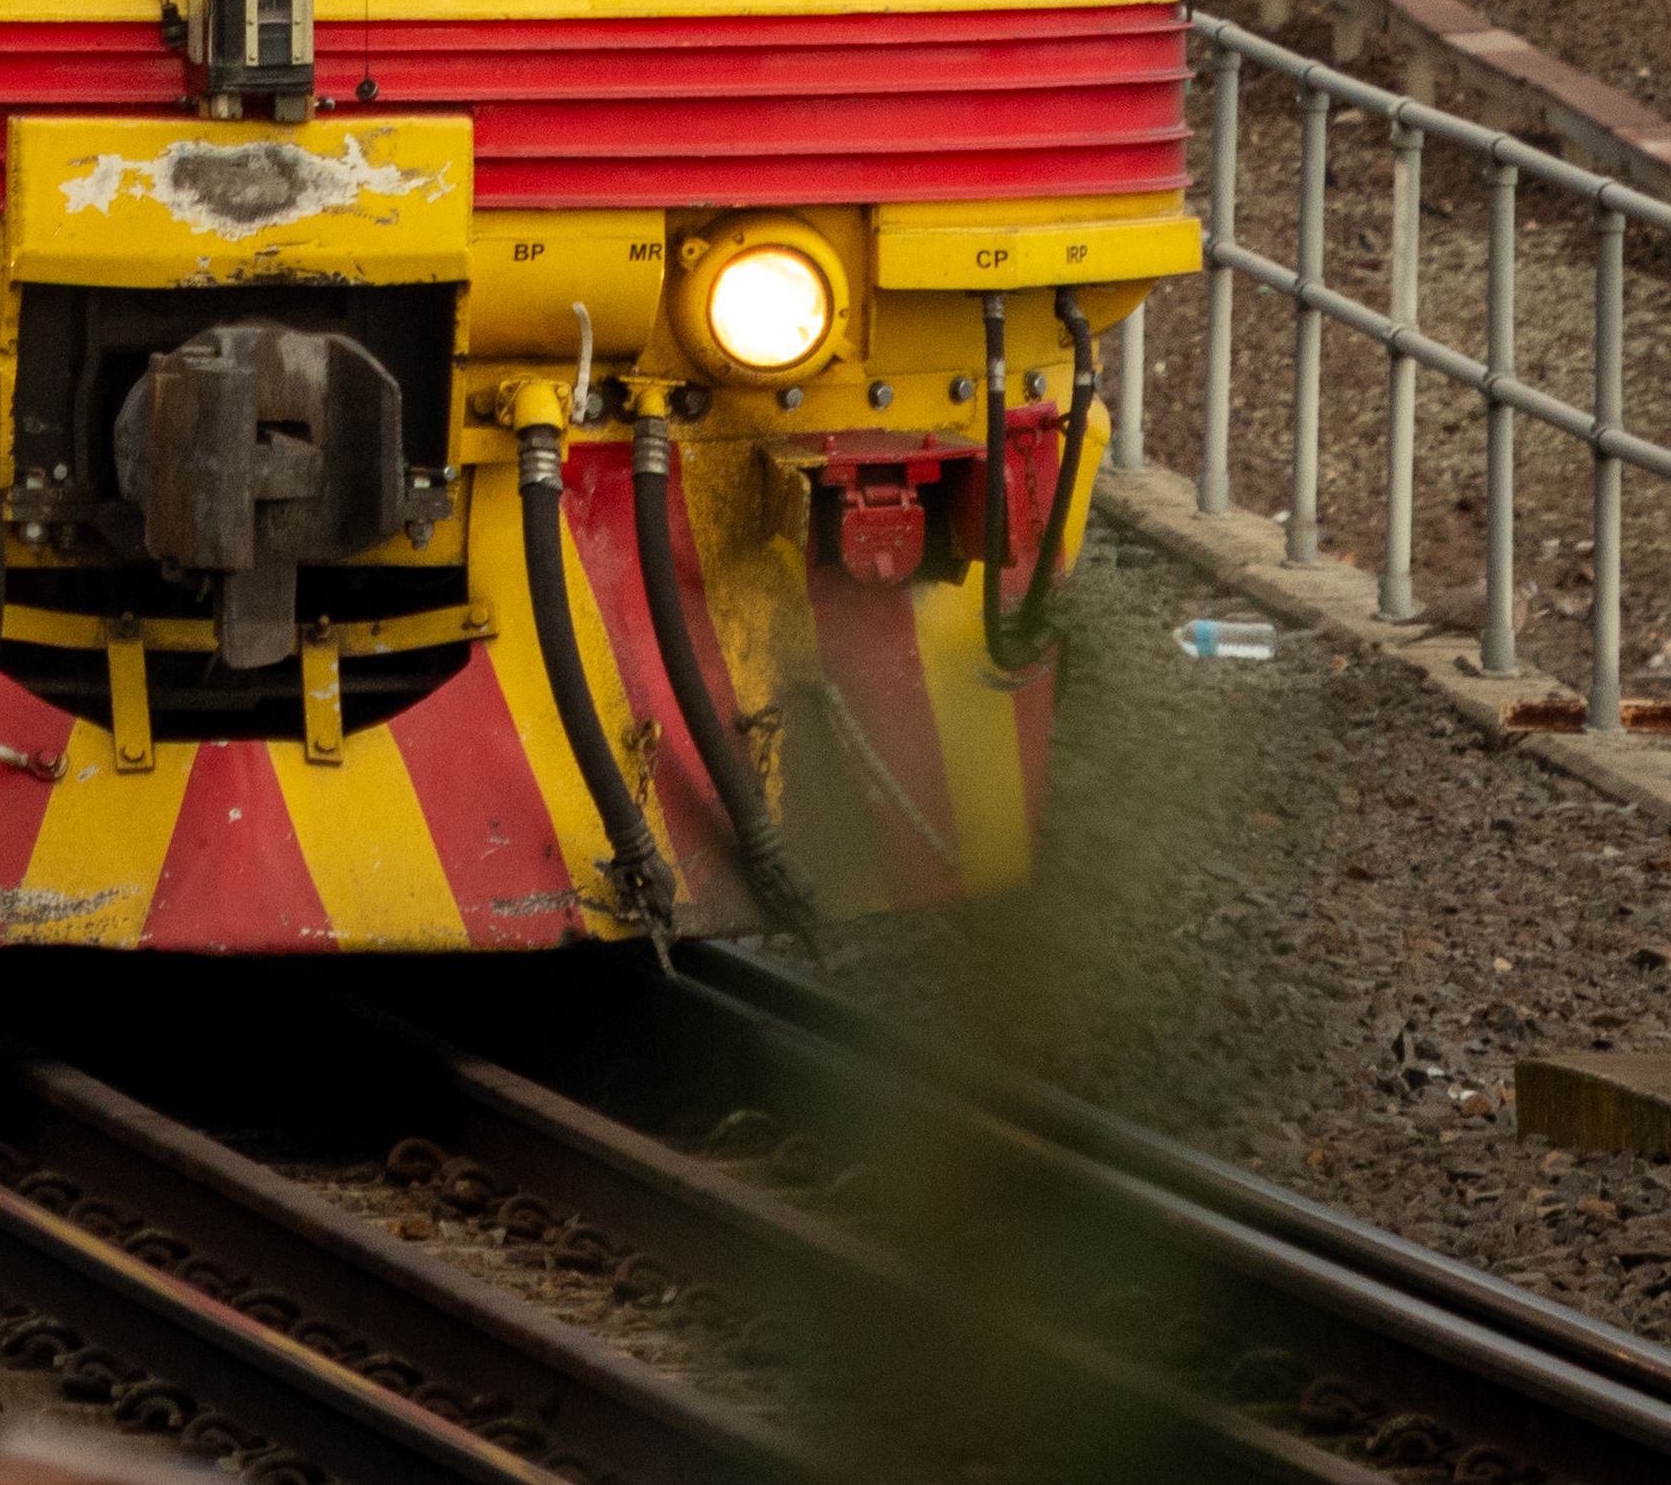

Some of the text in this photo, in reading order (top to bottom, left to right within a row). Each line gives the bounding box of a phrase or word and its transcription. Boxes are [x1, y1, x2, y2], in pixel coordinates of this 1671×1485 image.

[513, 241, 545, 262] BP
[628, 241, 663, 261] MR
[975, 248, 1009, 269] CP
[1065, 243, 1088, 264] IRP
